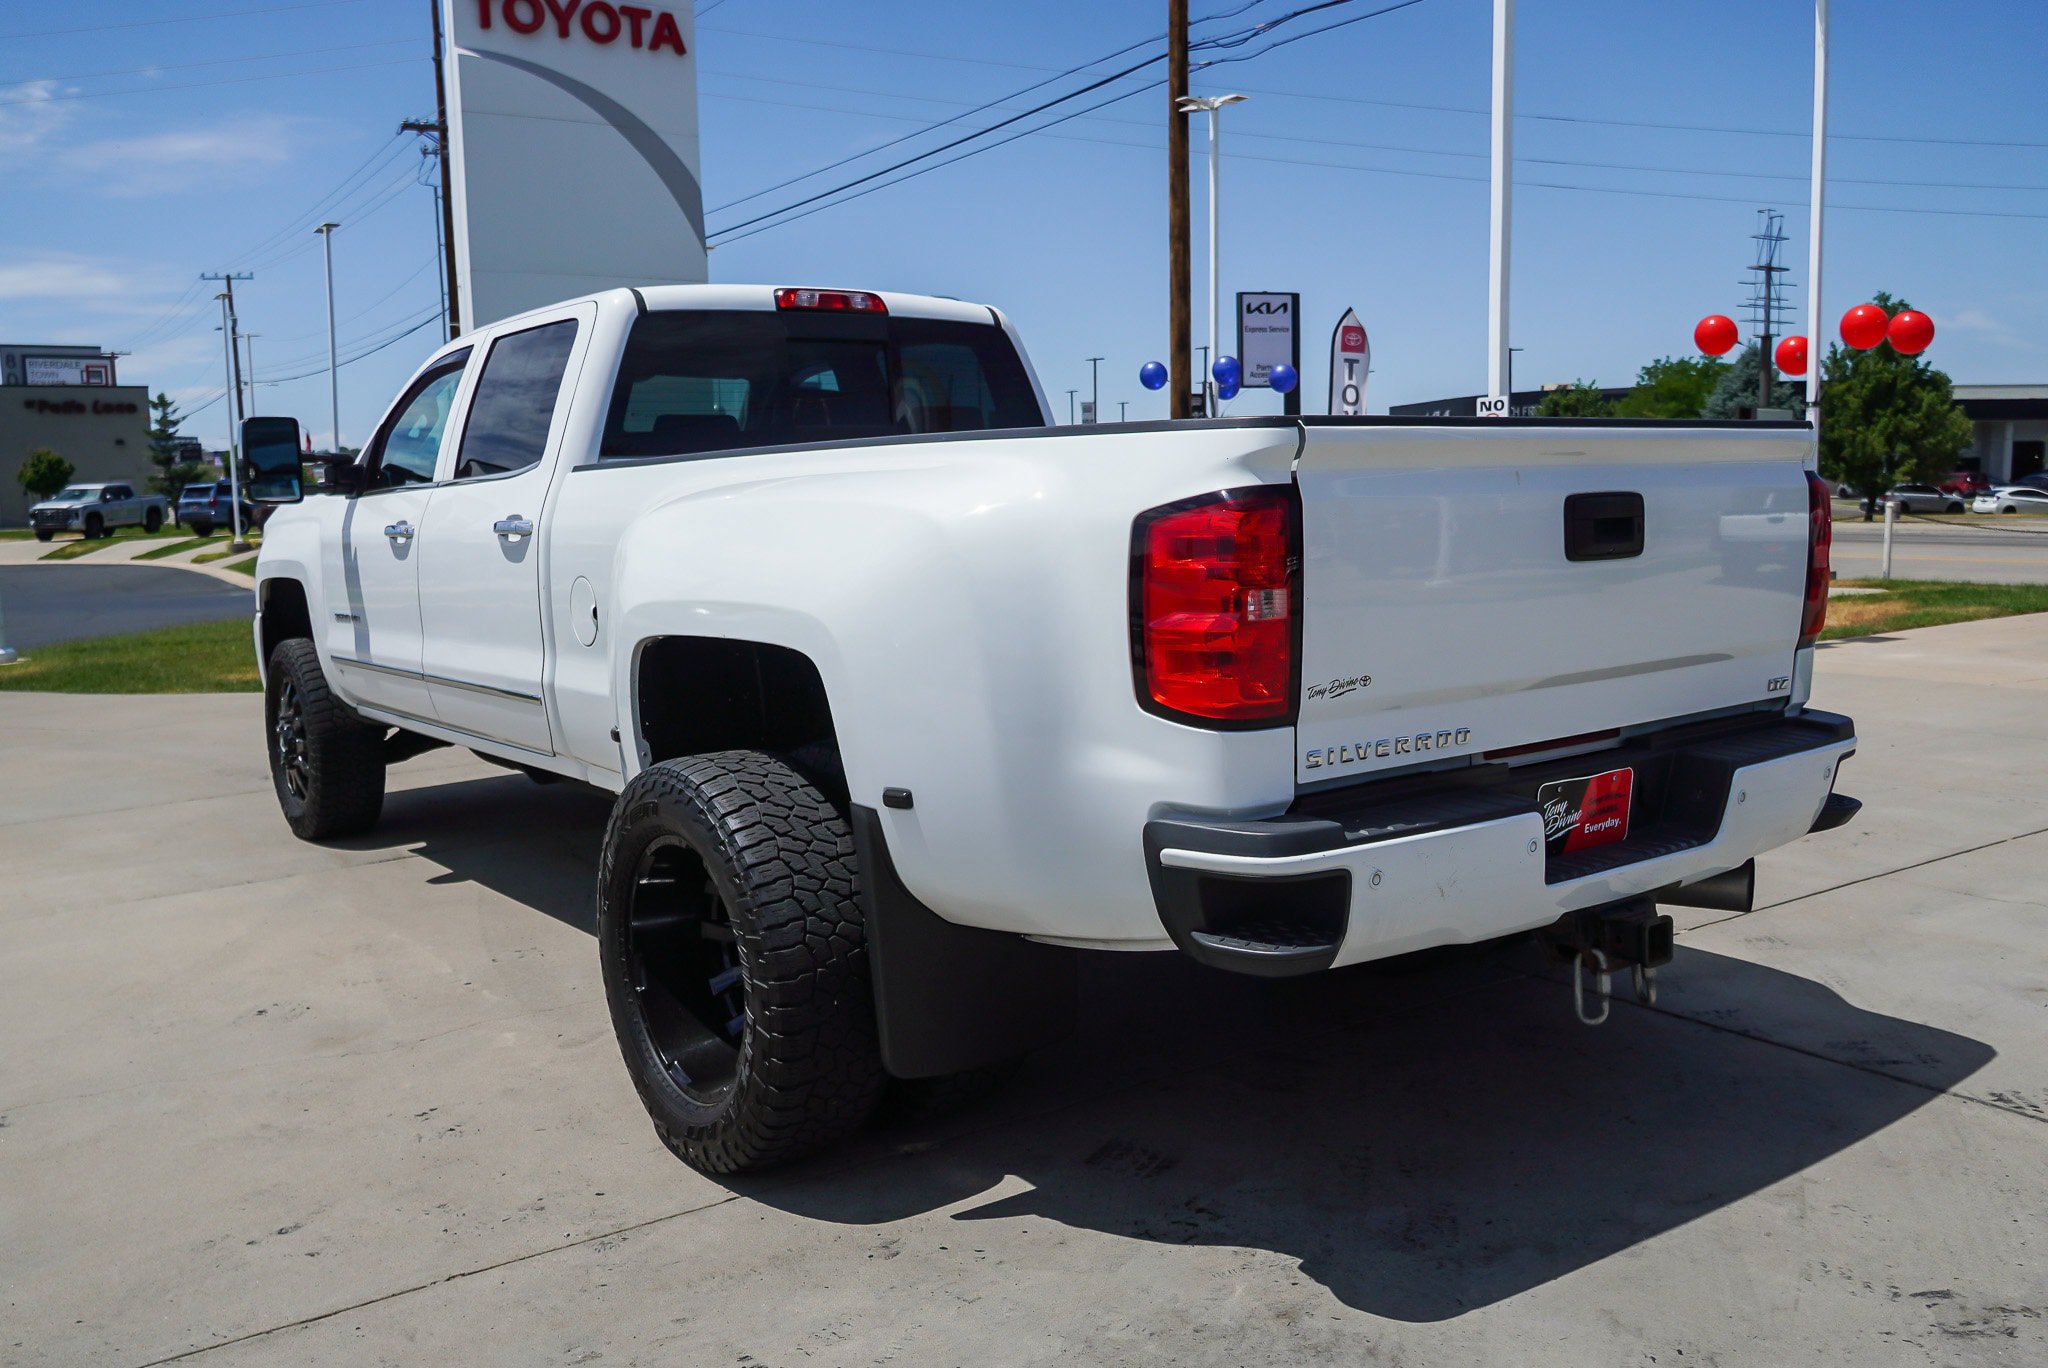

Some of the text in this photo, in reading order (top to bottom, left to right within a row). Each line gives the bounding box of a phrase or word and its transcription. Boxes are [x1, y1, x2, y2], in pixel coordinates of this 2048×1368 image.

[478, 0, 687, 56] TOYOTA
[1246, 302, 1288, 315] KIA
[1269, 325, 1290, 333] Service
[1341, 358, 1361, 415] TO
[1479, 399, 1505, 412] NO
[1307, 676, 1359, 700] Tony Divino
[1305, 727, 1471, 769] SILVERADO
[1543, 797, 1568, 819] Tony
[1545, 809, 1582, 835] Divino
[1584, 817, 1621, 834] Everyday.
